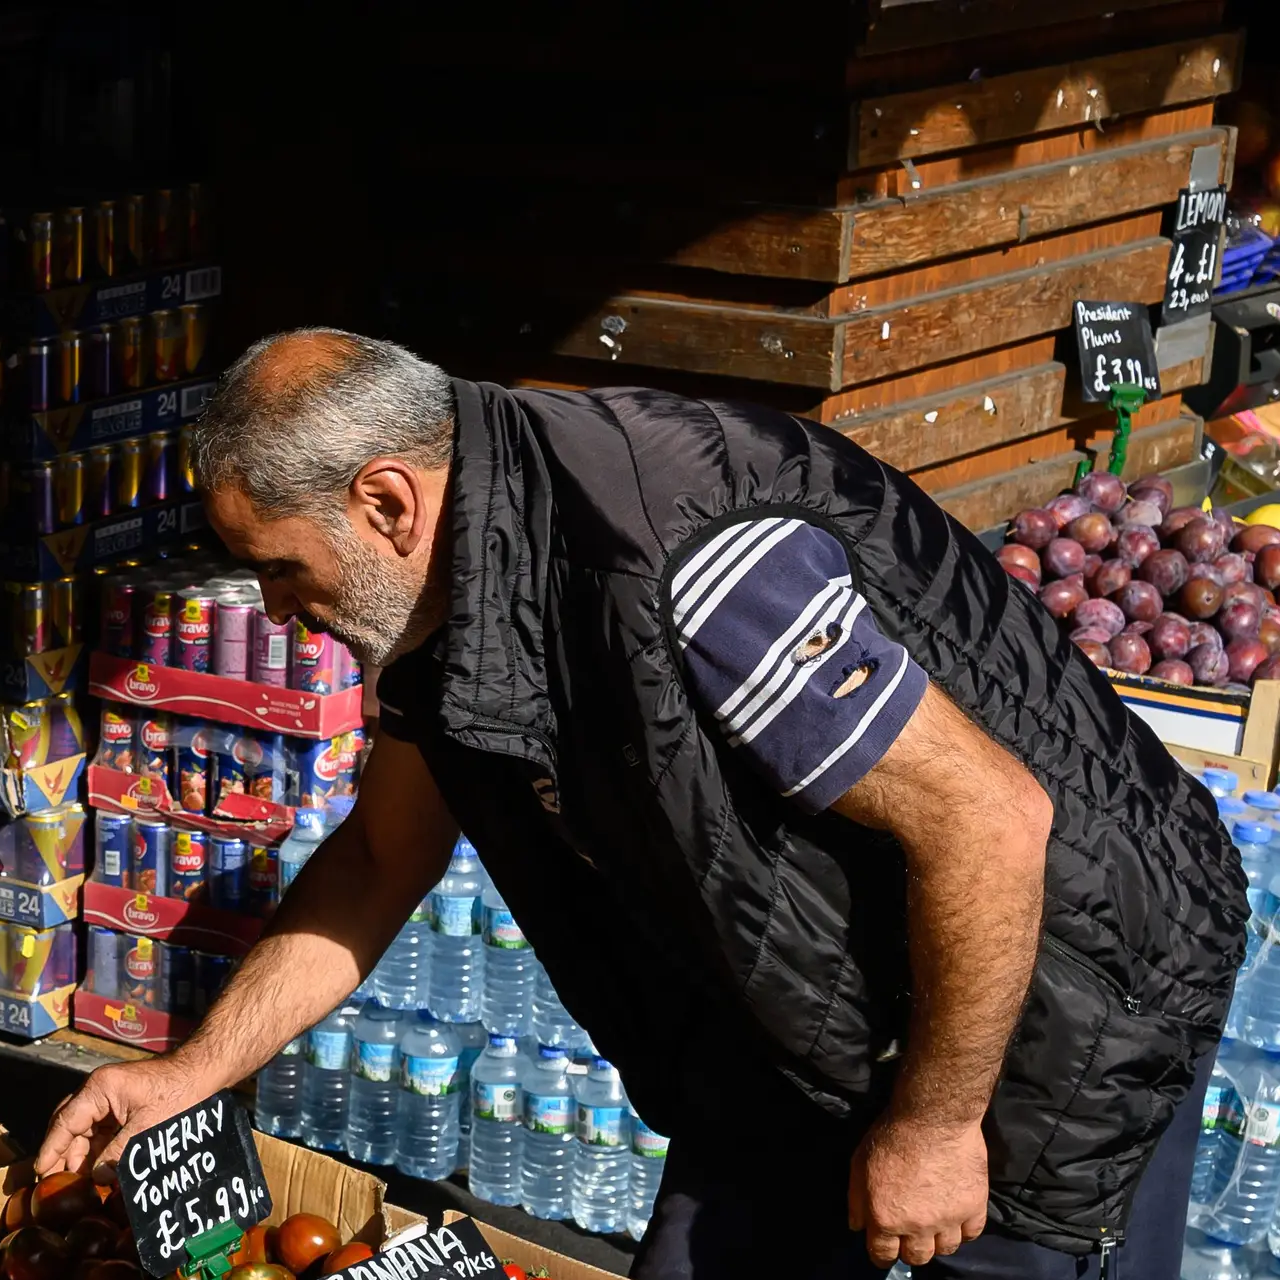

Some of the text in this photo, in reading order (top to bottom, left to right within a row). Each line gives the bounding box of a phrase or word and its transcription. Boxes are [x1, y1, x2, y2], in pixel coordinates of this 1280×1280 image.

[1177, 191, 1227, 231] LEMON
[1169, 242, 1217, 288] 4 £1
[161, 275, 183, 300] 24
[1075, 300, 1133, 326] President
[1081, 326, 1123, 351] Plums
[157, 390, 178, 418] 24
[157, 507, 178, 534] 24
[128, 680, 156, 693] bravo
[17, 892, 42, 917] 24
[126, 908, 156, 923] bravo
[8, 1003, 31, 1028] 24
[128, 1099, 224, 1182] CHERRY
[132, 1150, 217, 1213] TOMATO
[155, 1175, 266, 1259] £5.99 KG
